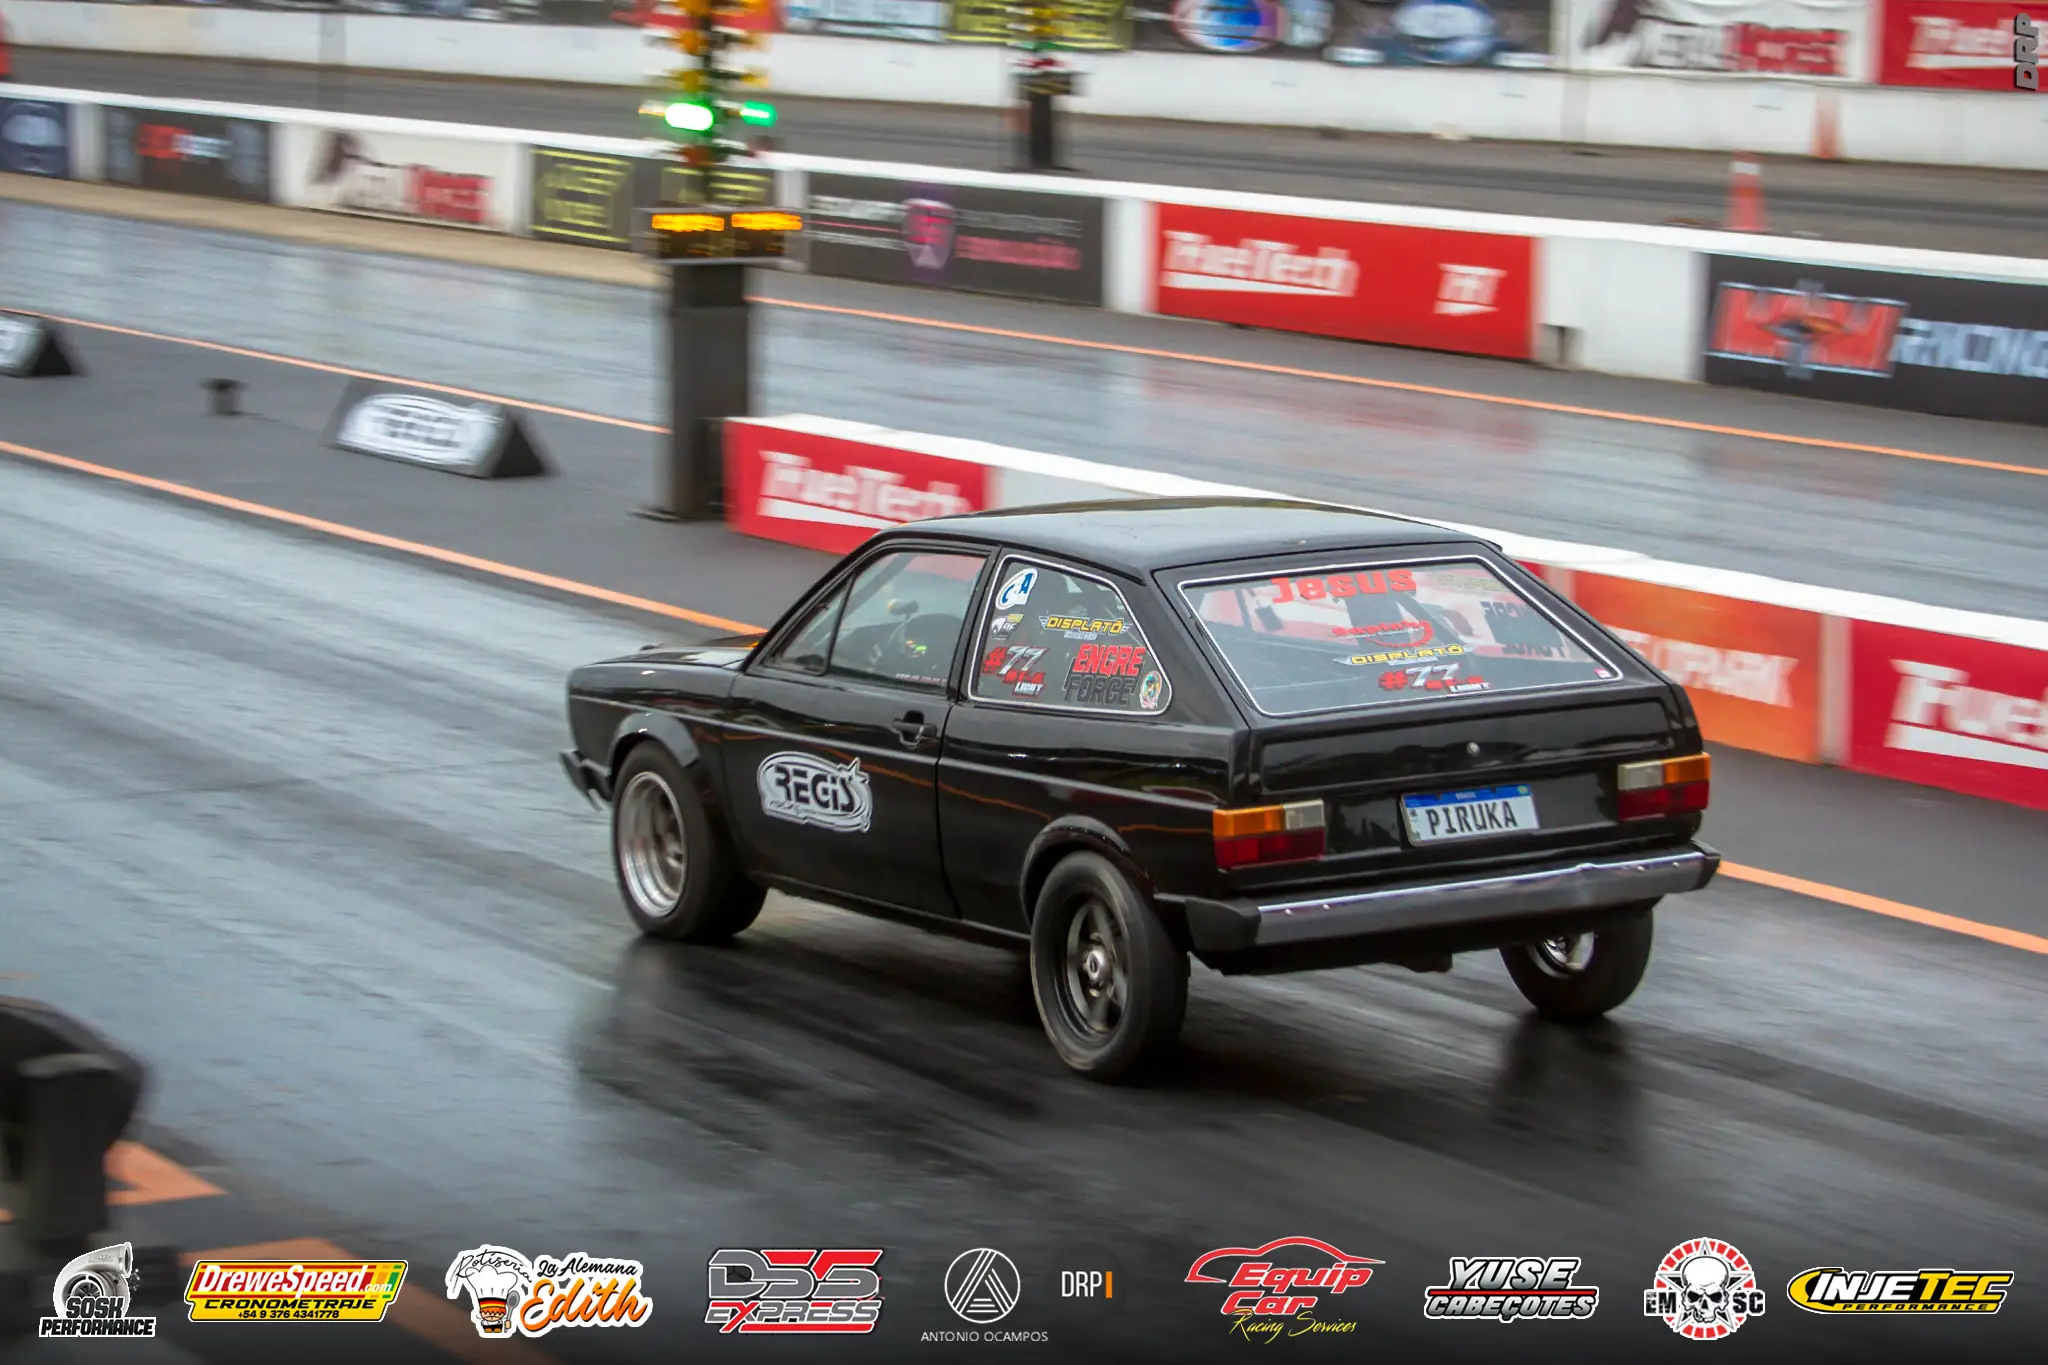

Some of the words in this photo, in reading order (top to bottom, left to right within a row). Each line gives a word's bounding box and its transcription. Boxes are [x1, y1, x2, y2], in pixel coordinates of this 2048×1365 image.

[981, 645, 1047, 676] #77
[1377, 663, 1461, 692] #77
[774, 764, 856, 813] REGIS
[1425, 800, 1518, 836] PIRUKA
